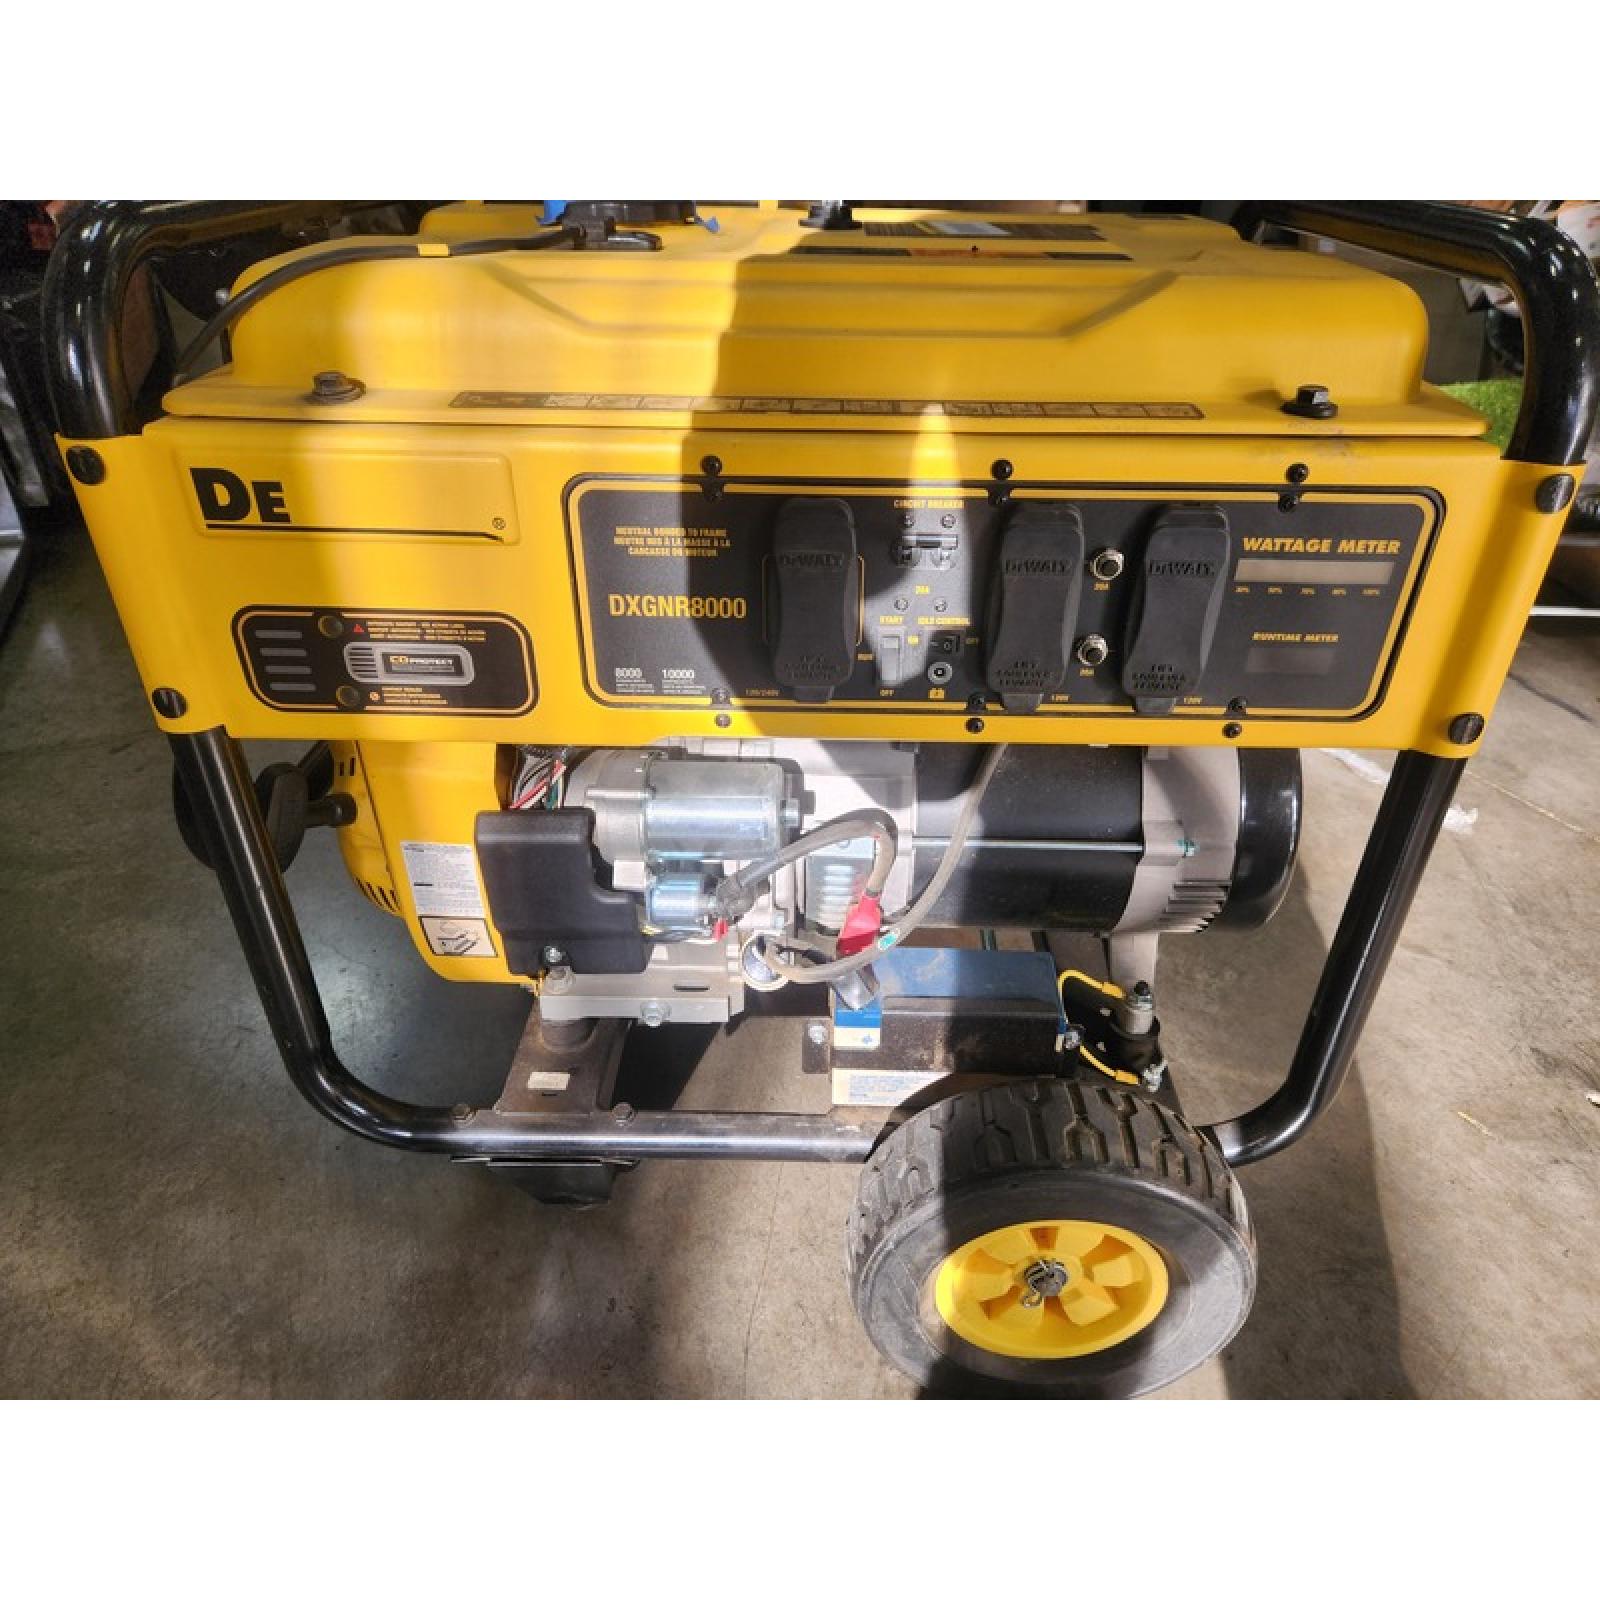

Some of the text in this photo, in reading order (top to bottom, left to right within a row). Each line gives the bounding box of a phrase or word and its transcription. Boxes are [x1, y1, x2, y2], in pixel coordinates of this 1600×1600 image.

[190, 468, 291, 523] DE
[1242, 537, 1400, 554] WATTAGE METER
[608, 593, 747, 618] DXGNR8000
[1252, 631, 1340, 643] RUNTIME METER
[661, 669, 695, 680] 10000
